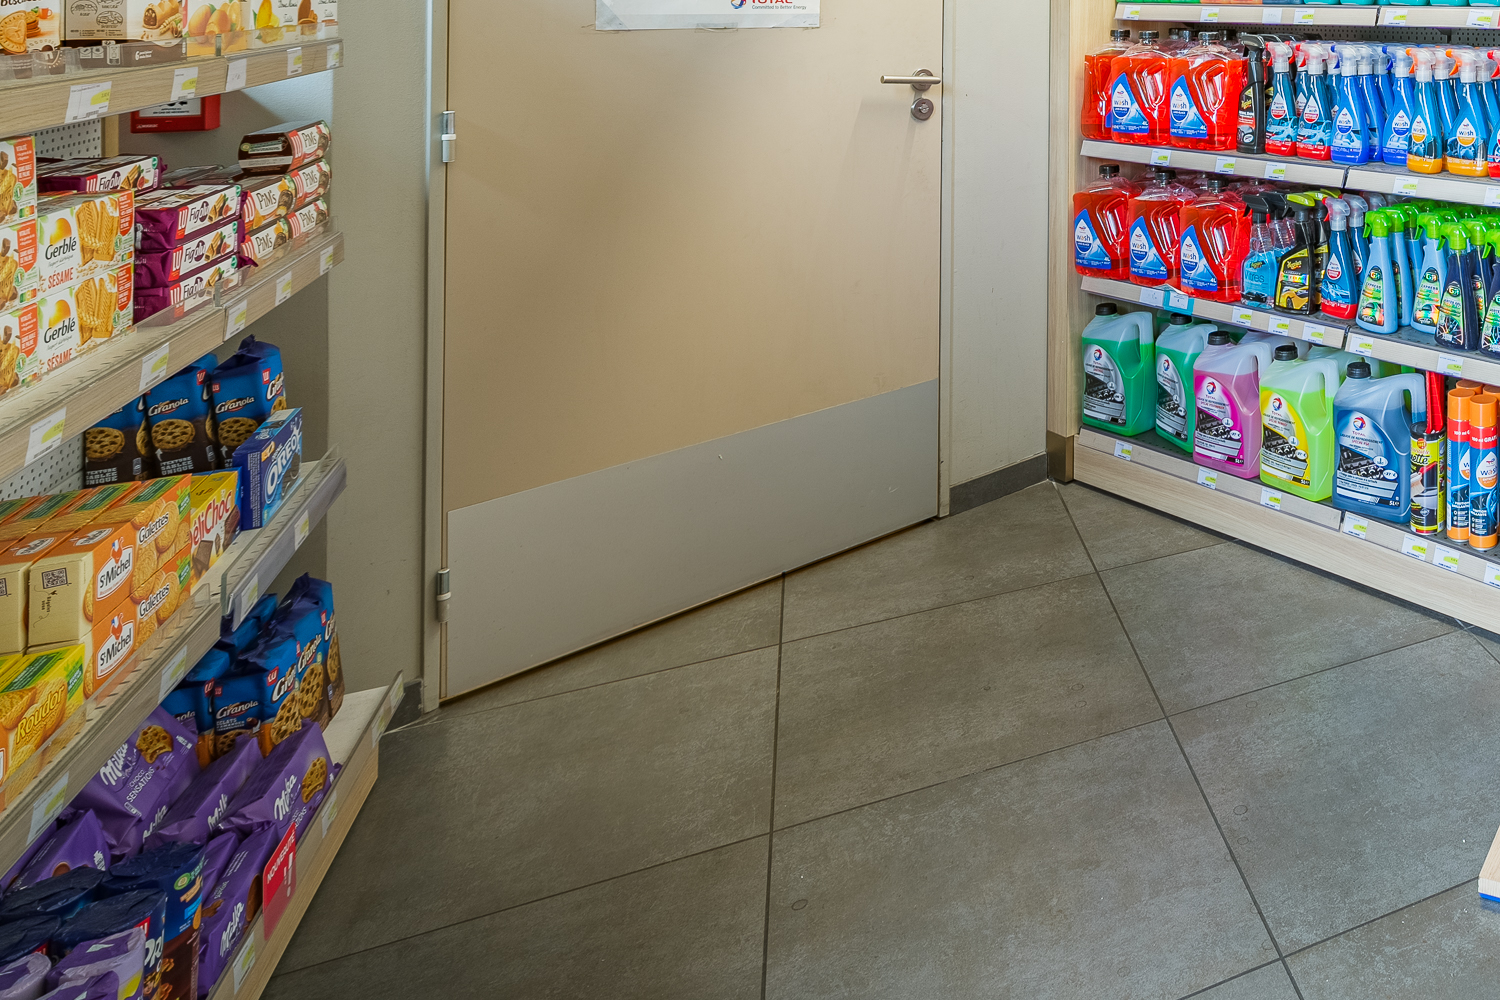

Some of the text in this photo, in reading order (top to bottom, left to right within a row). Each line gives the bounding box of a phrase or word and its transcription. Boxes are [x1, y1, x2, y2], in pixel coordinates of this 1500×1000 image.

[1114, 98, 1129, 107] wash
[1172, 101, 1187, 110] wash
[179, 208, 187, 229] LU
[45, 236, 77, 260] Gerblé
[1076, 233, 1091, 242] wash
[1132, 241, 1147, 251] wash
[172, 250, 180, 270] LU
[1183, 251, 1197, 260] wash
[48, 266, 74, 288] SÉSAME
[44, 316, 76, 344] Gerblé
[46, 347, 73, 371] SÉSAME
[148, 399, 189, 417] Granola
[215, 396, 255, 415] Granola
[161, 465, 194, 475] UNIQUE
[265, 435, 299, 504] OREO
[138, 511, 169, 544] Galettes
[107, 553, 132, 586] Michel
[139, 583, 170, 619] Galettes
[107, 628, 132, 662] Michel
[15, 686, 66, 745] Roudor
[216, 700, 259, 720] Granola
[100, 743, 129, 786] Milka
[127, 767, 155, 803] SENSATIONS
[274, 774, 298, 821] Milka
[220, 902, 244, 957] Milka
